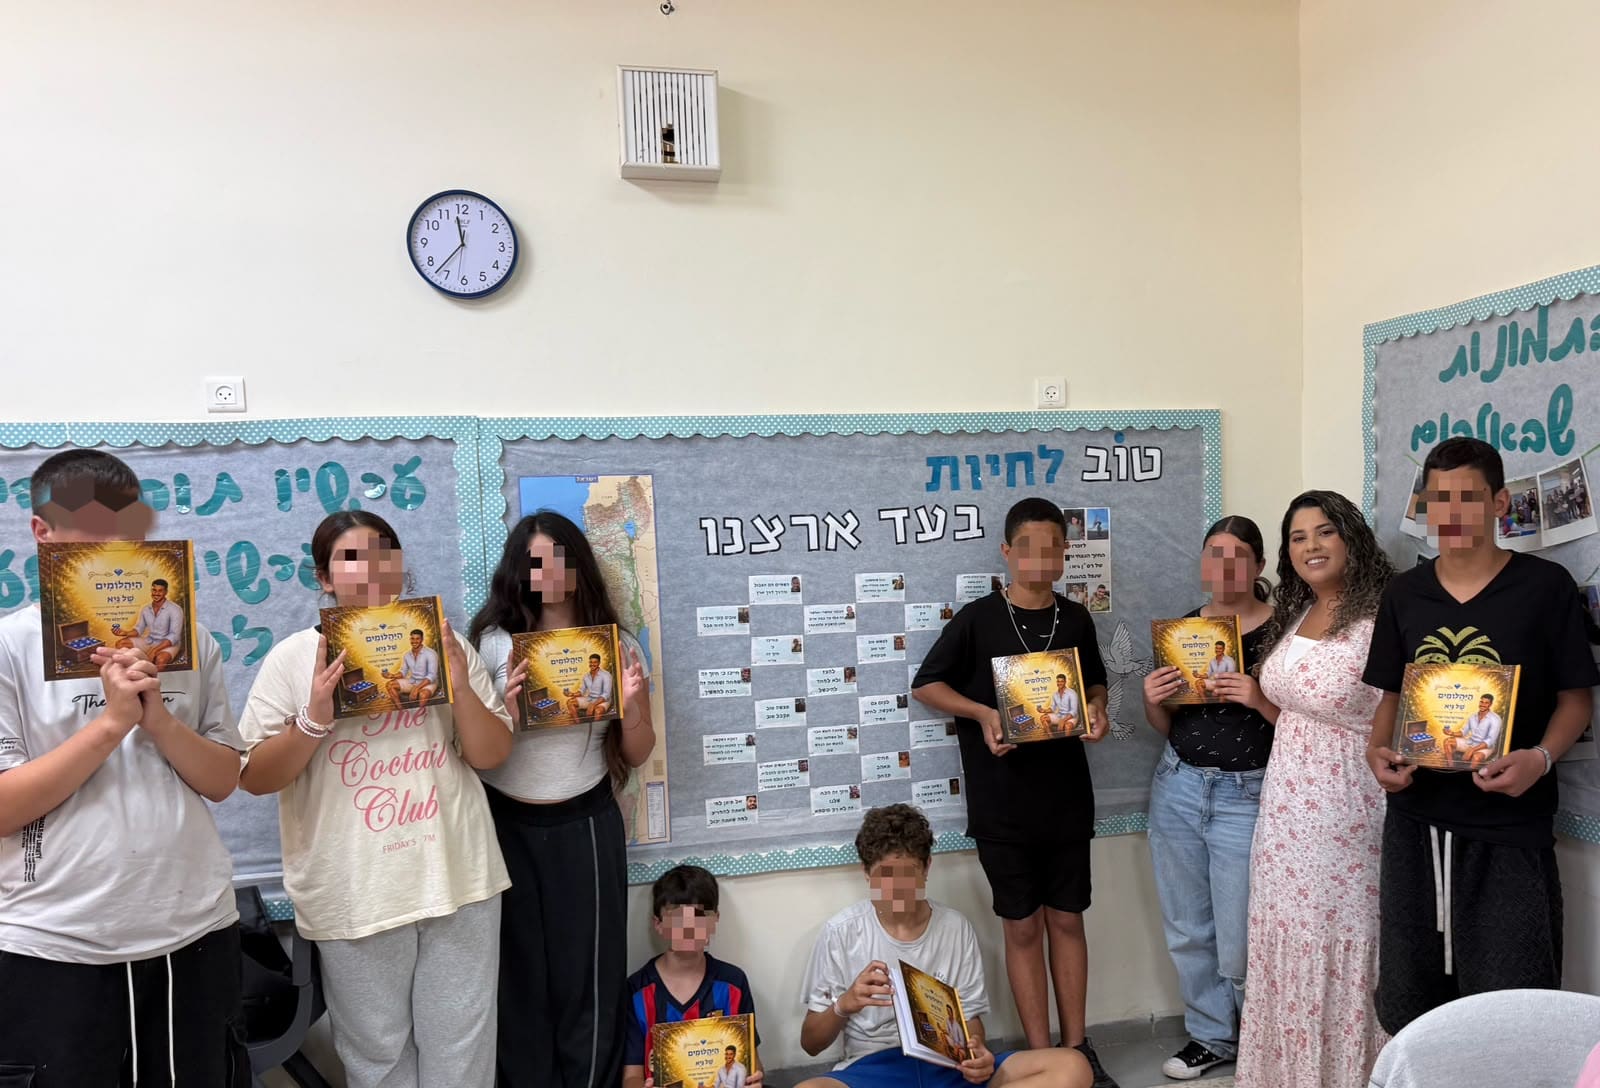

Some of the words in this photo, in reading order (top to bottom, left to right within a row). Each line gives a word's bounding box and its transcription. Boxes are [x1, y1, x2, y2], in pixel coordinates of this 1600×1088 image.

[438, 209, 449, 220] 11
[456, 204, 469, 215] 12
[479, 210, 483, 221] 1
[425, 219, 440, 231] 10
[491, 223, 499, 233] 2
[420, 237, 428, 248] 9
[498, 241, 506, 253] 3
[427, 256, 434, 266] 8
[492, 260, 499, 270] 4
[444, 269, 450, 281] 7
[460, 275, 468, 286] 6
[479, 272, 487, 282] 5
[1081, 431, 1163, 483] טוב
[925, 444, 1066, 493] לחיות
[274, 455, 427, 515] עכשיו
[878, 503, 986, 545] בעד
[699, 509, 863, 556] ארצנו
[71, 694, 107, 715] The
[328, 736, 447, 787] Coctail
[353, 785, 439, 832] Club
